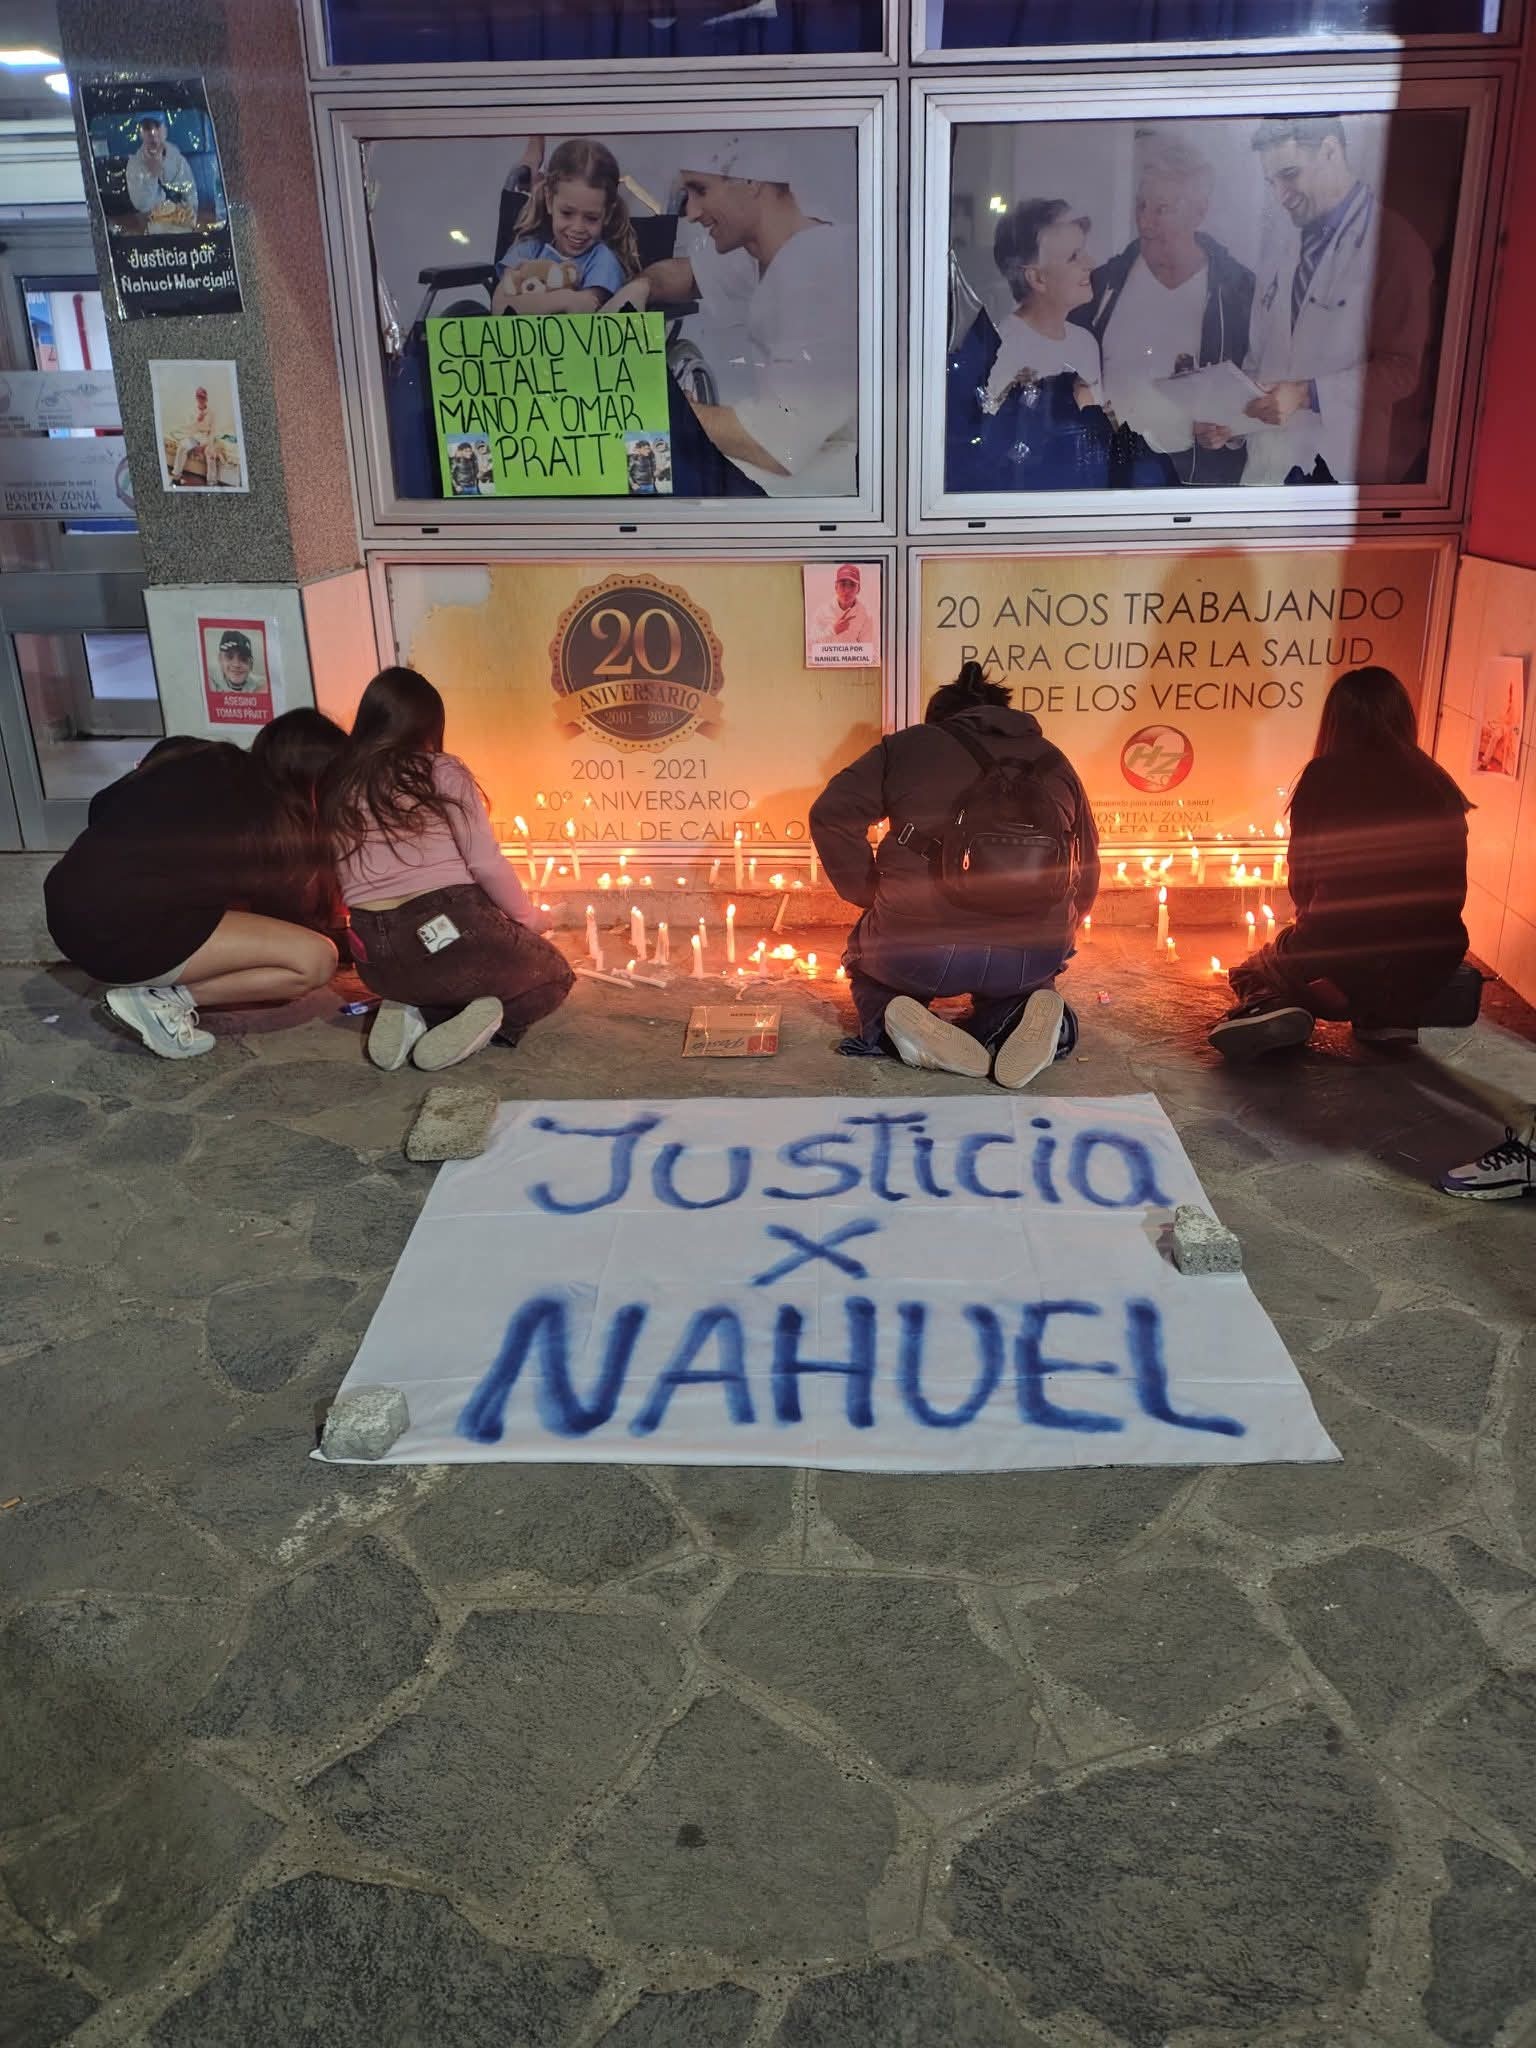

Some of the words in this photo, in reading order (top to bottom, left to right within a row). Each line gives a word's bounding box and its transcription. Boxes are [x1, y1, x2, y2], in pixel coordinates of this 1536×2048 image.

[129, 247, 188, 268] Justicia
[190, 248, 214, 270] por
[438, 357, 568, 398] SOLTALE
[594, 357, 635, 393] LA
[439, 396, 518, 434] MANO
[527, 397, 549, 432] A
[937, 595, 980, 629] 20
[993, 587, 1109, 628] AÑOS
[1124, 586, 1405, 625] TRABAJANDO
[590, 607, 683, 676] 20
[960, 644, 1052, 672] PARA
[1064, 641, 1198, 671] CUIDAR
[1209, 639, 1251, 668] LA
[1261, 637, 1374, 667] SALUD
[578, 680, 701, 713] ANIVERSARIO
[1021, 685, 1065, 713] DE
[1075, 683, 1137, 712] LOS
[1150, 680, 1304, 711] VECINOS
[570, 760, 626, 779] 2001
[653, 758, 708, 779] 2021
[582, 788, 752, 811] ANIVERSARIO
[639, 821, 673, 841] DE
[1097, 824, 1148, 834] ALETA
[524, 1110, 1178, 1215] Justicia
[455, 1293, 1247, 1445] NAHUEL
